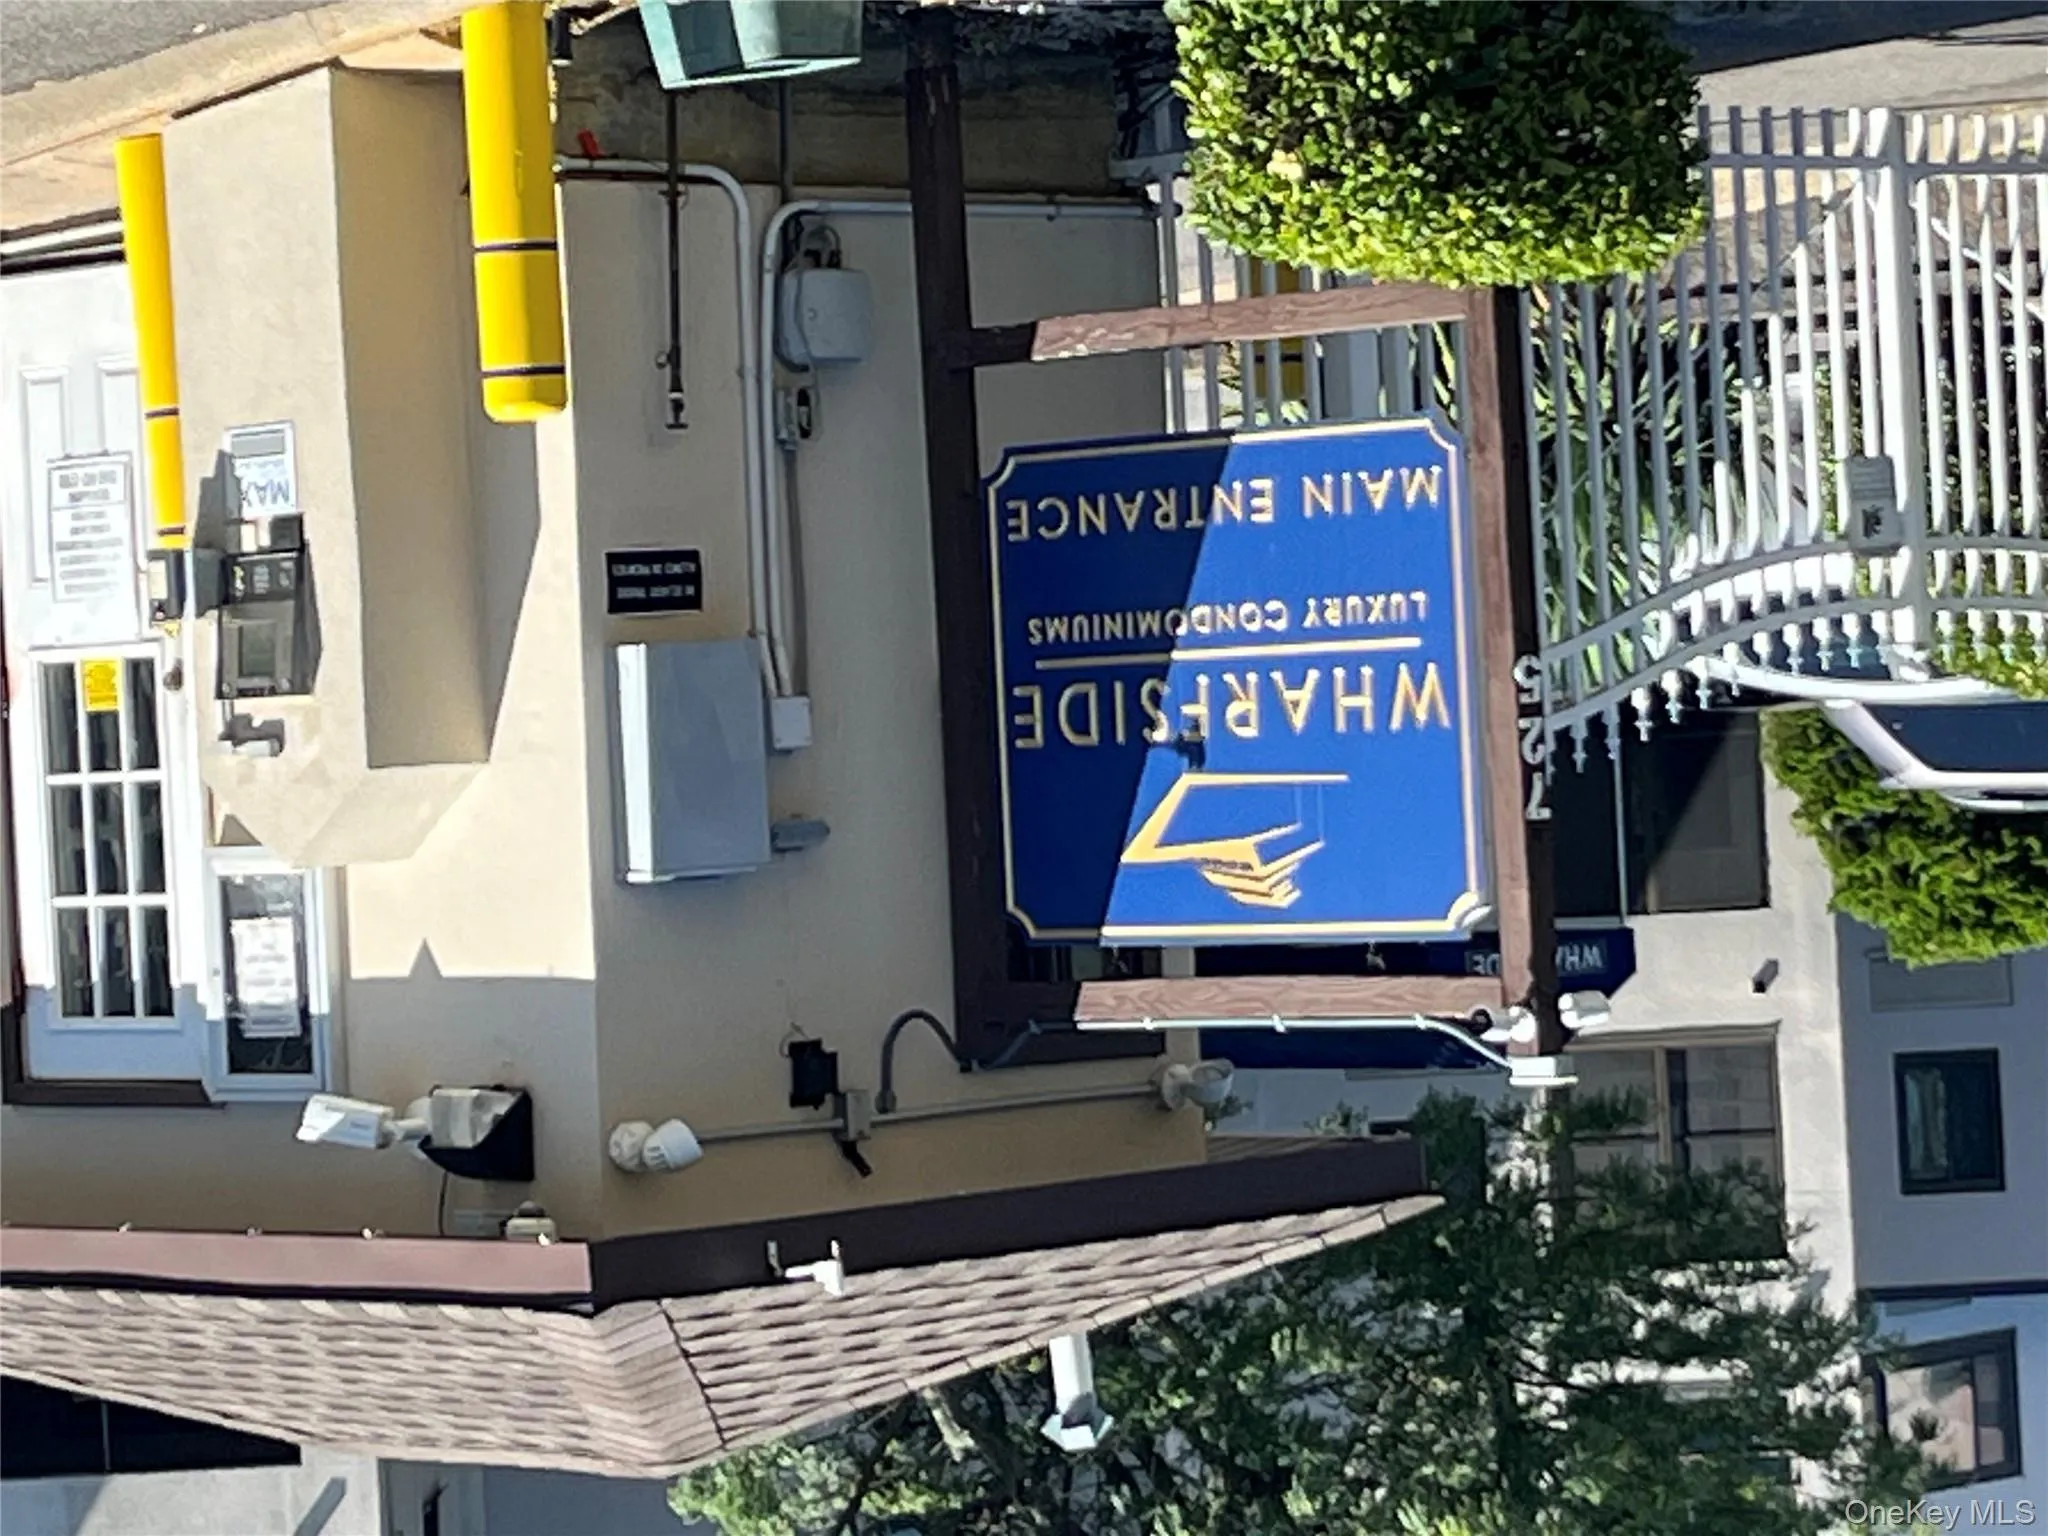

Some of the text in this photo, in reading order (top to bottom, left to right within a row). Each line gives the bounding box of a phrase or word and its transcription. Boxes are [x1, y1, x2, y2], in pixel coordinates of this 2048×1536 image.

[1005, 465, 1442, 542] MAIN ENTRANCE
[1027, 590, 1428, 645] LUXURY CONDOMINIUMS
[1013, 662, 1451, 749] WHARFSIDE
